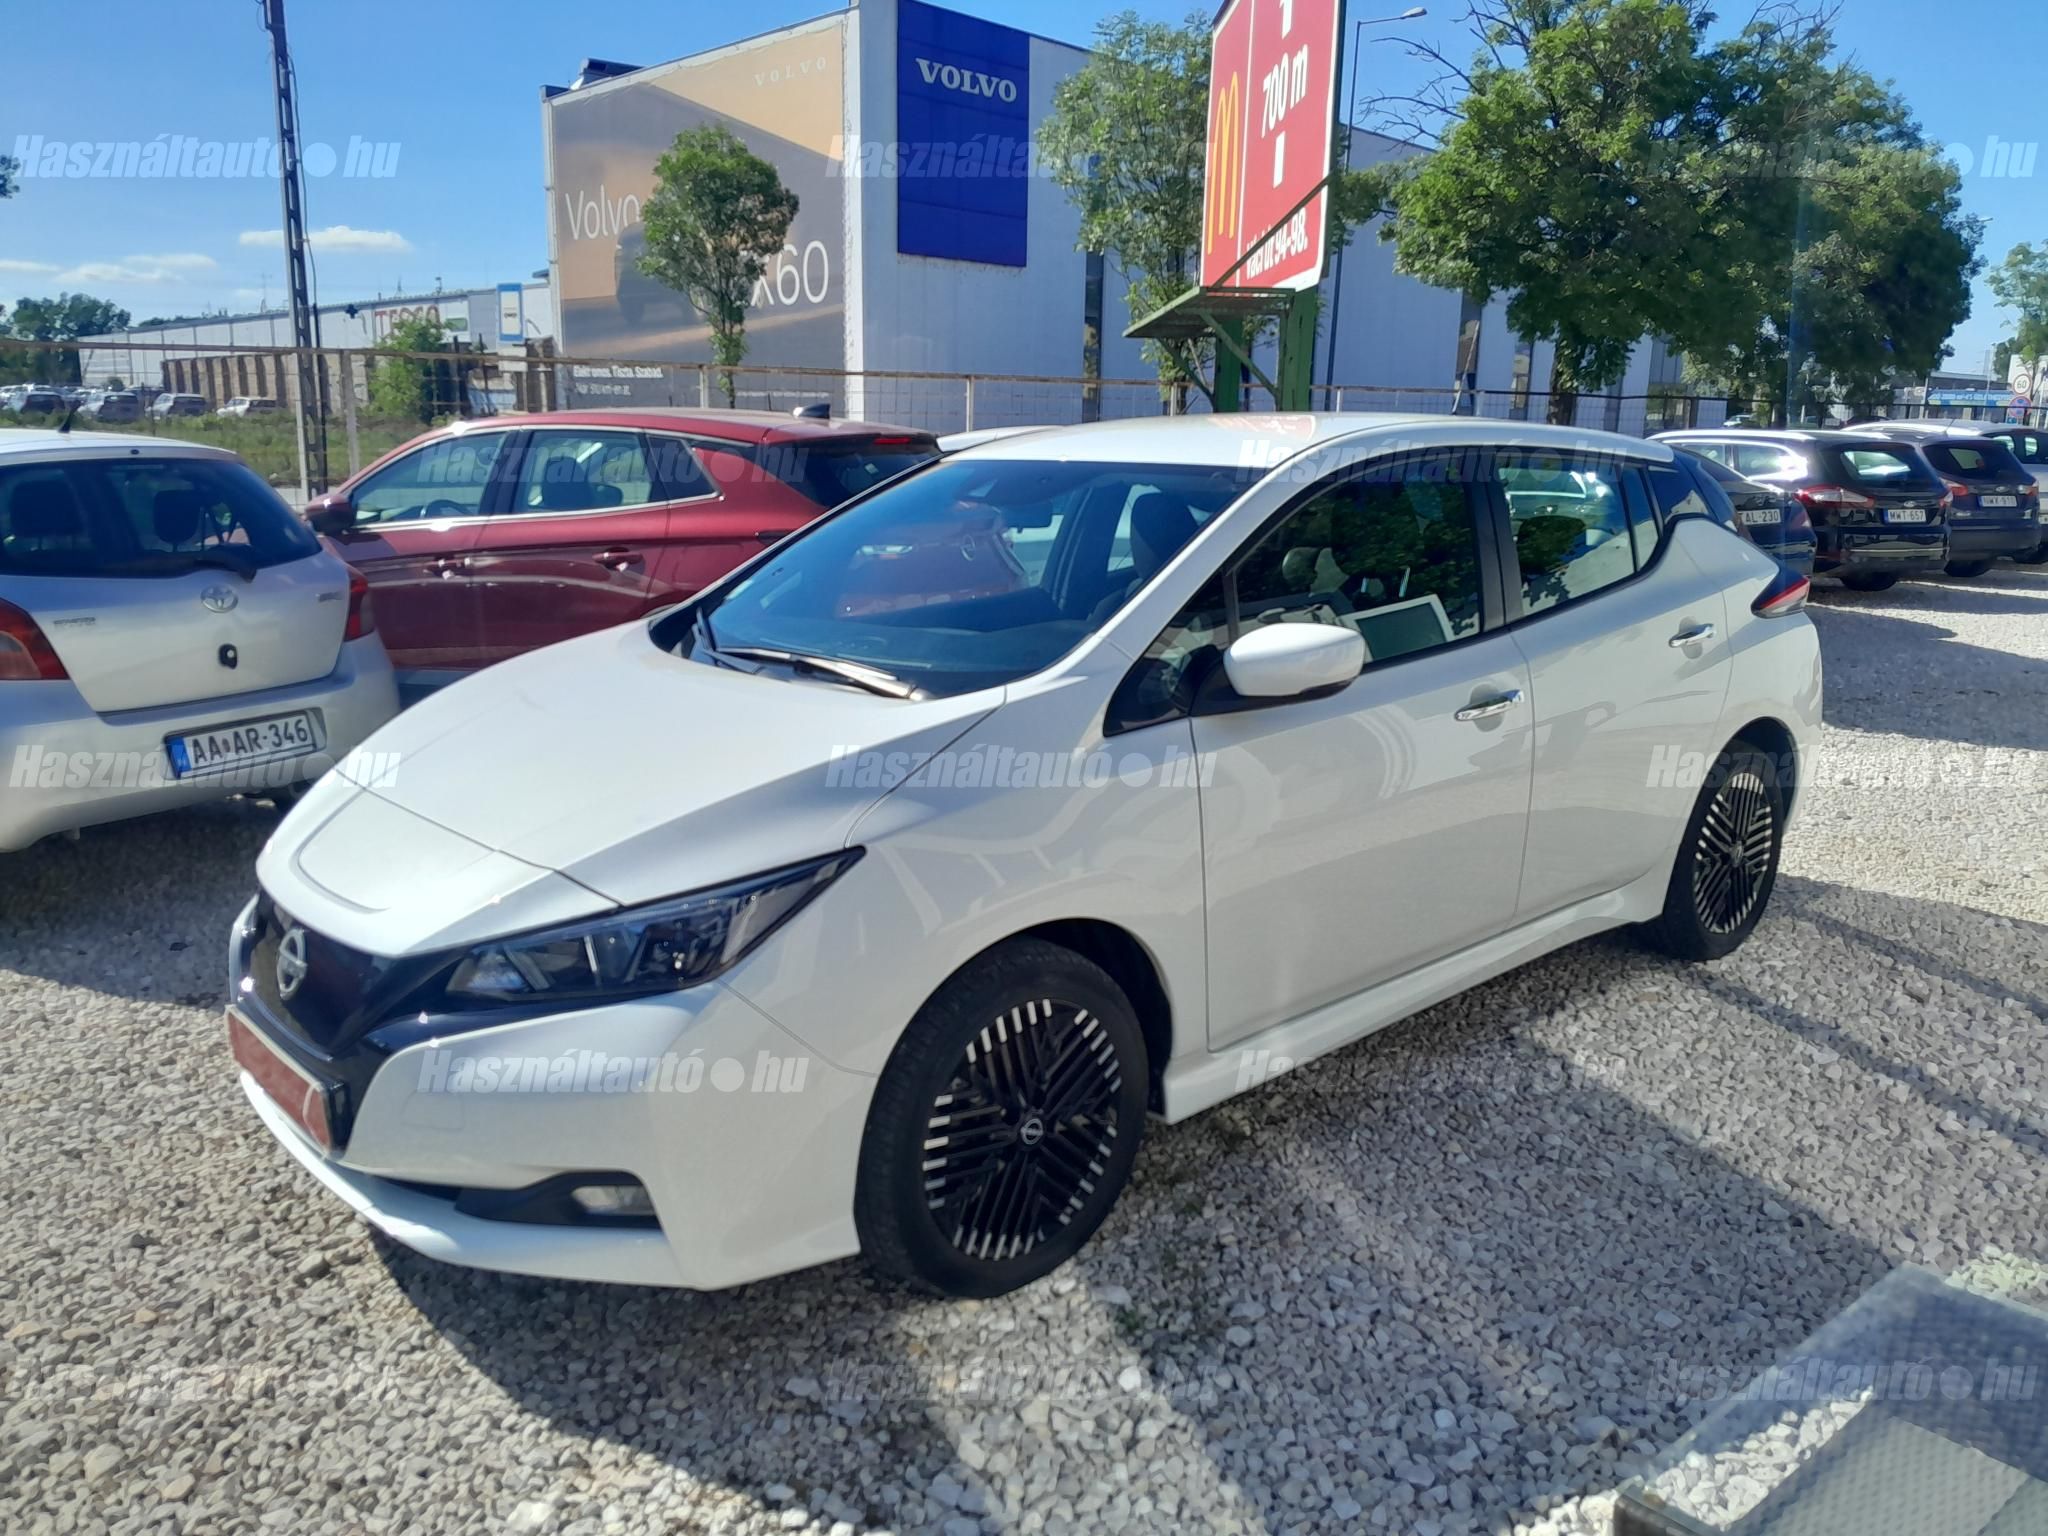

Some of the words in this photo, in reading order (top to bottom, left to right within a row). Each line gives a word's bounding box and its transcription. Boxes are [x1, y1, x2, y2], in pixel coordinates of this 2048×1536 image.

[754, 57, 827, 87] VOLVO
[915, 58, 1017, 103] VOLVO
[1261, 51, 1289, 138] 700
[1290, 43, 1308, 109] m
[565, 184, 641, 240] Volvo
[2016, 380, 2028, 389] 60
